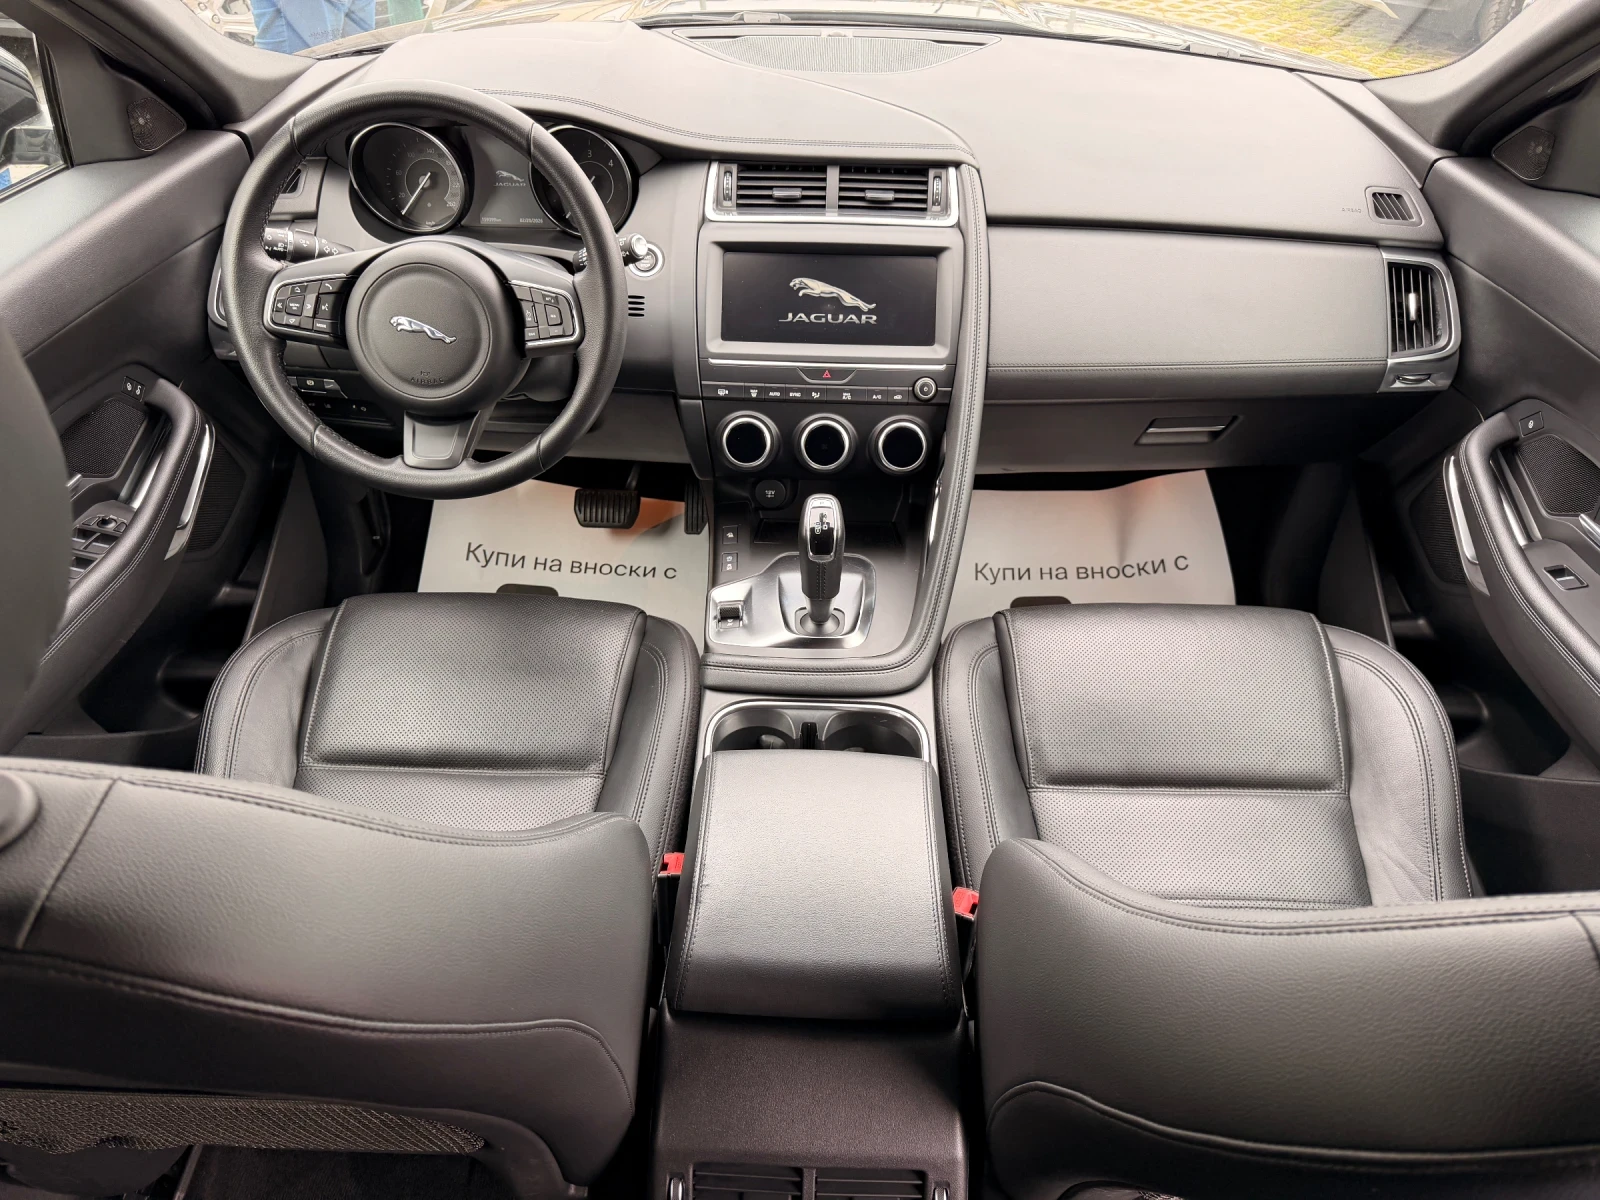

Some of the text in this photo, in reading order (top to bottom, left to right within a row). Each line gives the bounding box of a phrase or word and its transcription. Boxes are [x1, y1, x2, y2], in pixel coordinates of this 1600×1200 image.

[587, 150, 592, 158] 3
[608, 159, 614, 167] 4
[778, 312, 878, 325] JAGUAR
[465, 541, 678, 580] Купи на вноски с
[974, 562, 1032, 586] Купи
[1039, 565, 1069, 581] на
[1075, 558, 1167, 581] вноски
